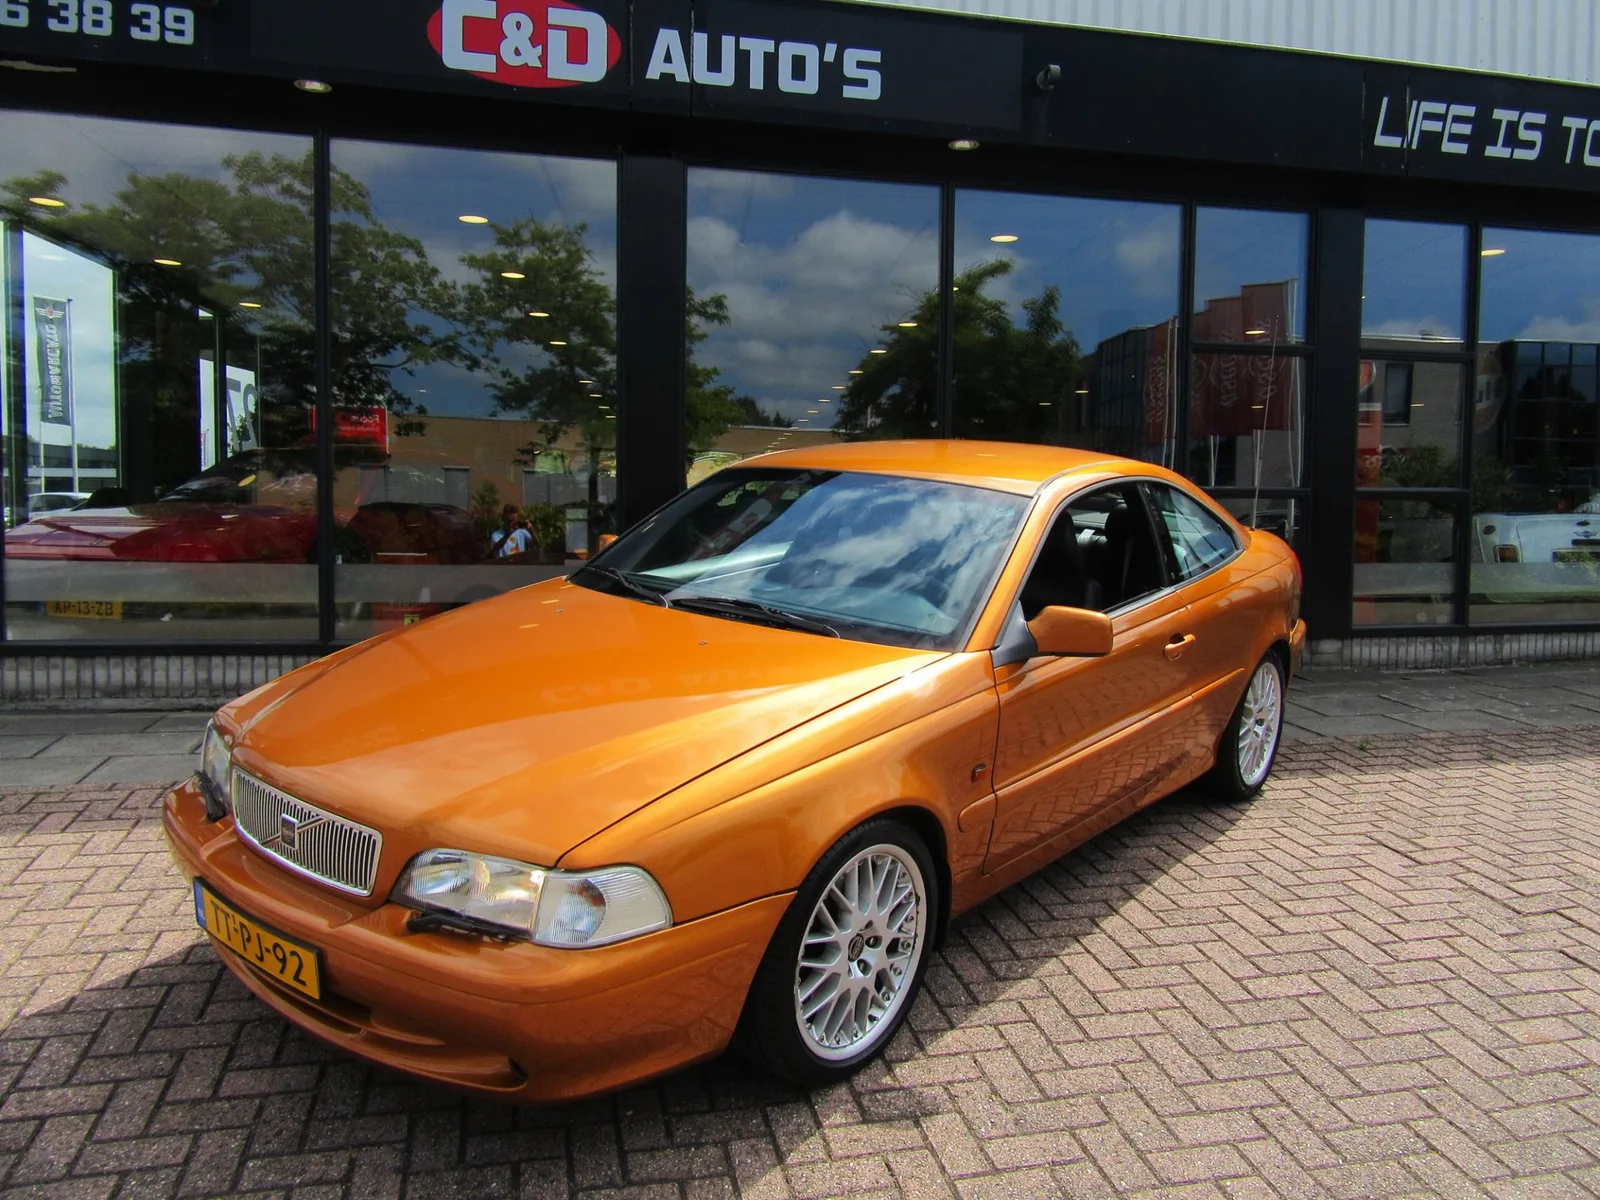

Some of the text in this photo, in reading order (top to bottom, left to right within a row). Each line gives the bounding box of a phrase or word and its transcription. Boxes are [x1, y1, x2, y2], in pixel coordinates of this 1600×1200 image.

[48, 0, 113, 37] 38
[130, 3, 195, 45] 39
[441, 0, 882, 100] C&D AUTO'S
[1374, 96, 1477, 154] LIFE
[1484, 108, 1547, 161] IS
[210, 899, 307, 987] TT-PJ-92
